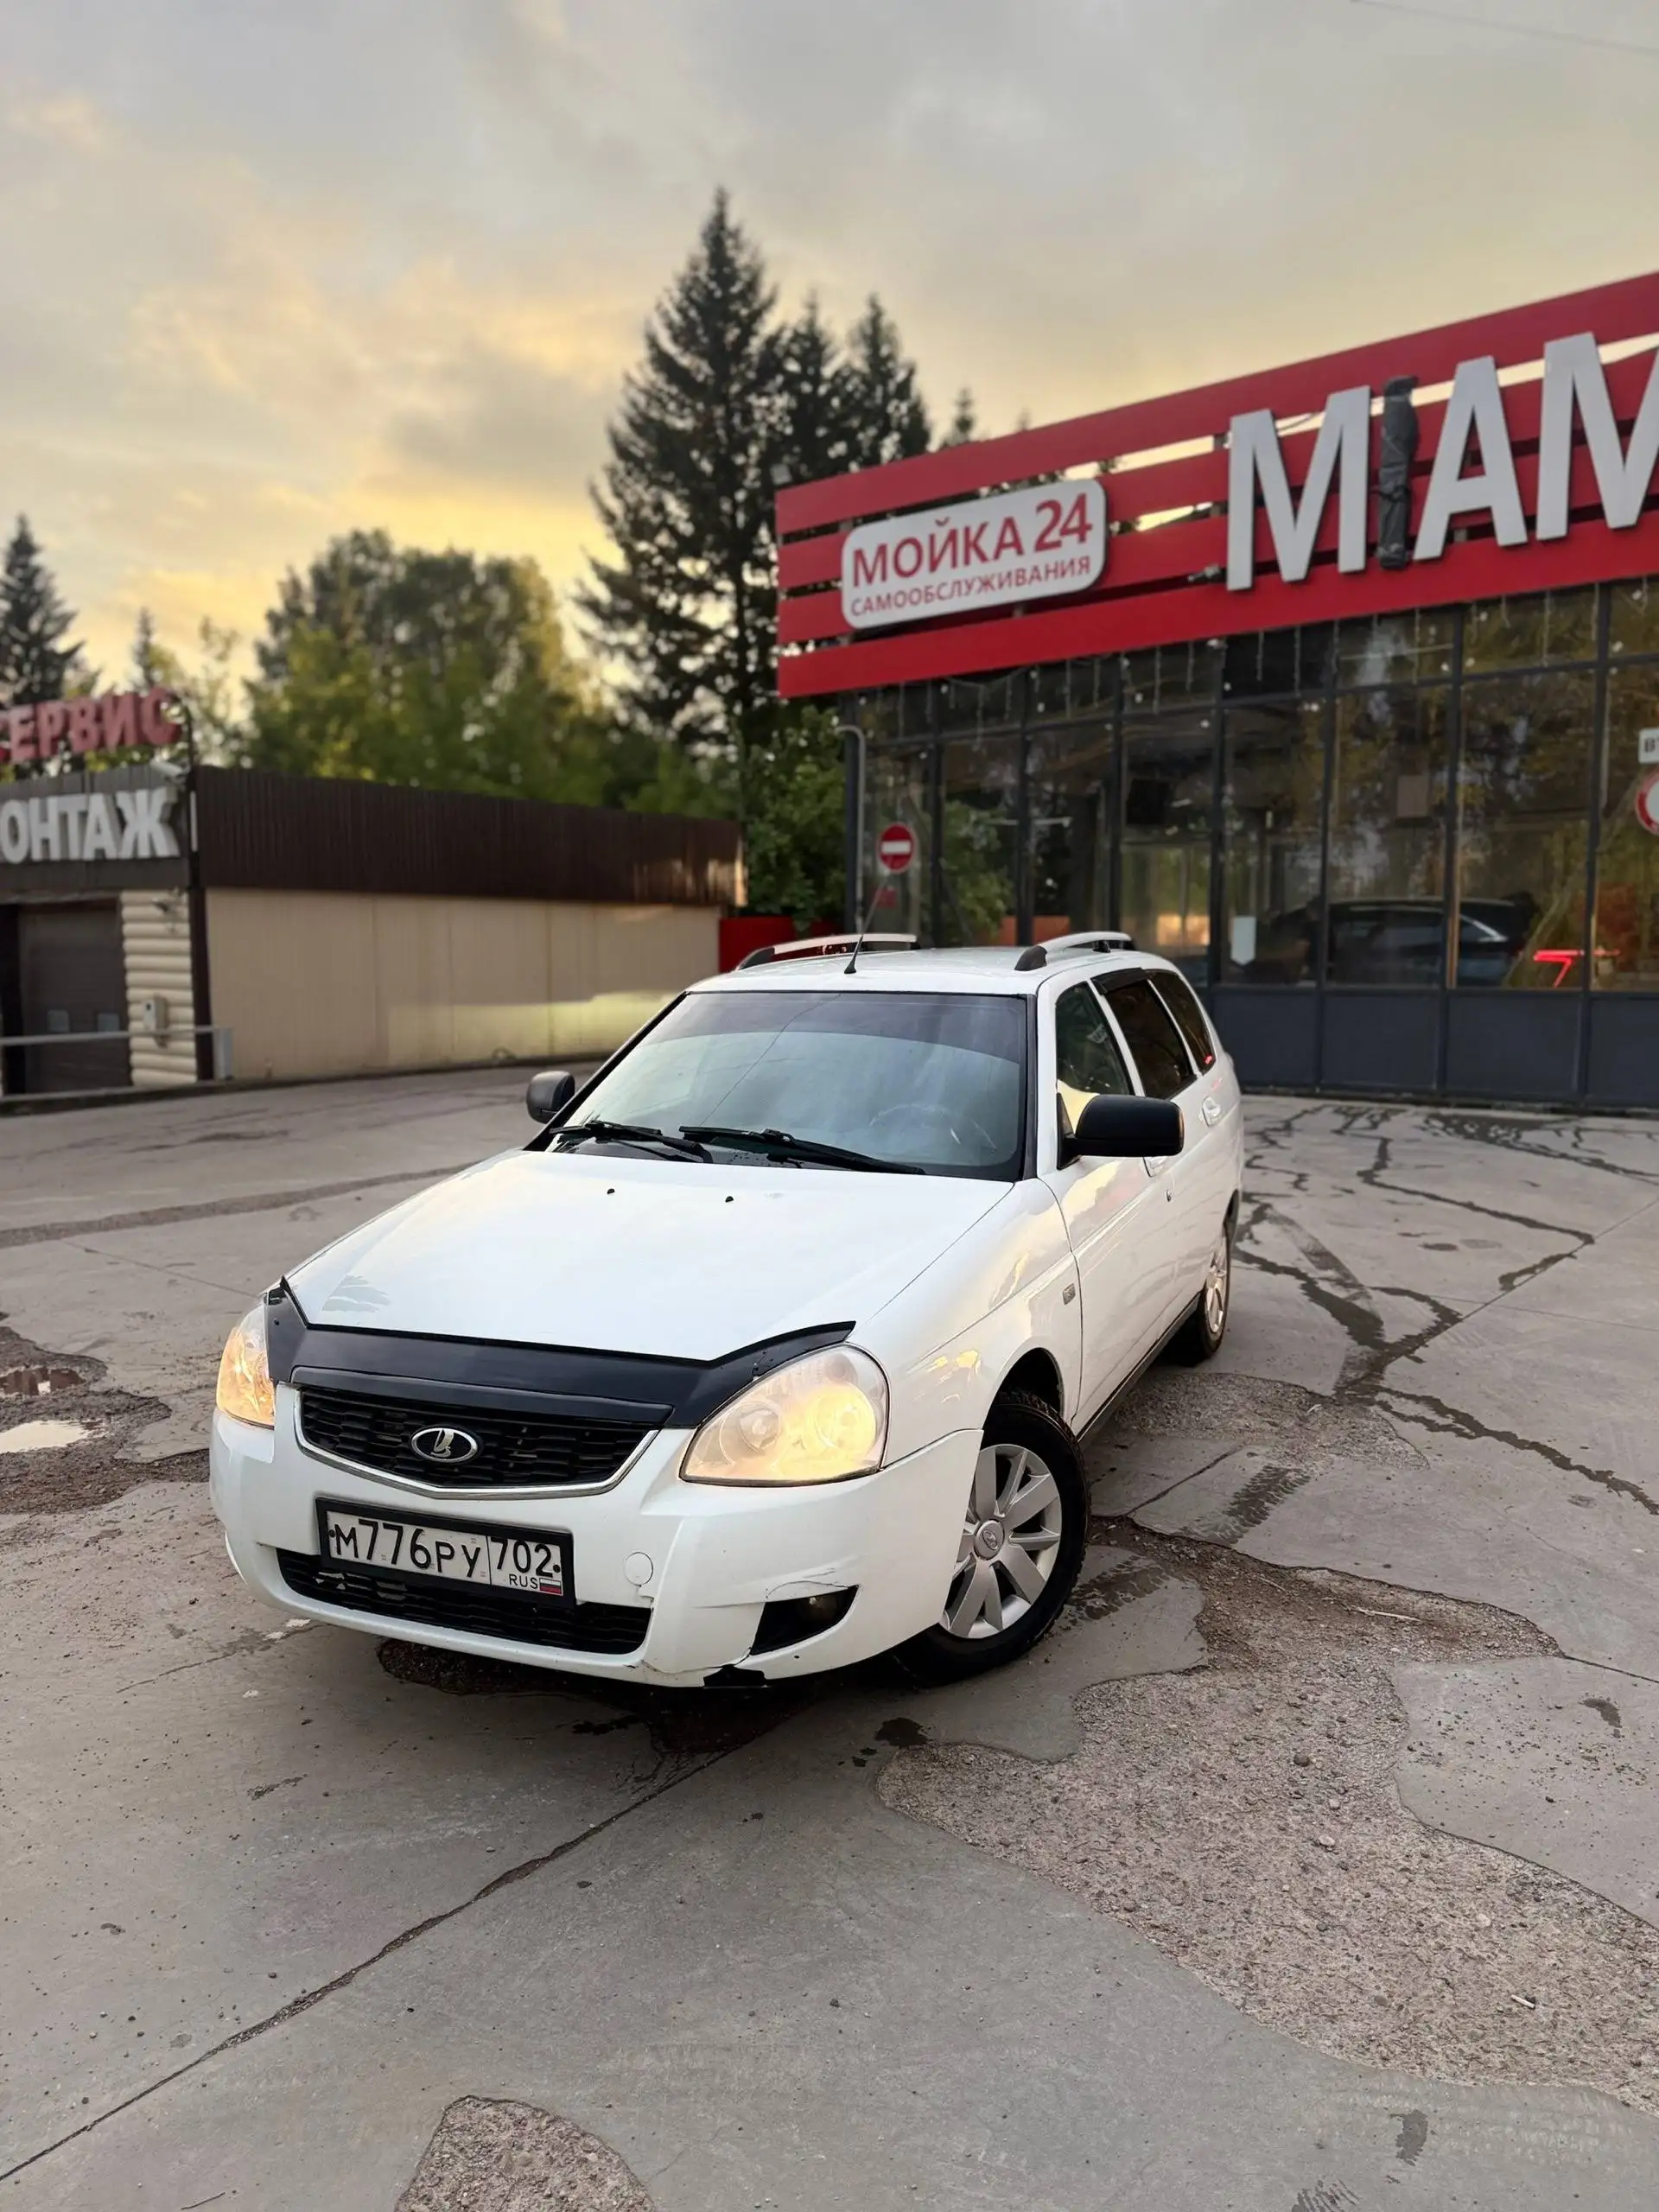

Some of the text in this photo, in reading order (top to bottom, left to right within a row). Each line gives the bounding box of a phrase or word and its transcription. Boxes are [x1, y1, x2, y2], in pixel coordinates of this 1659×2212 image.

[852, 493, 1093, 588] МОЙКА 24
[850, 555, 1091, 617] САМООБСЛУЖИВАНИЯ
[0, 786, 180, 864] ОНТАЖ
[334, 1518, 554, 1578] М776РУ 702
[508, 1573, 538, 1590] RUS
